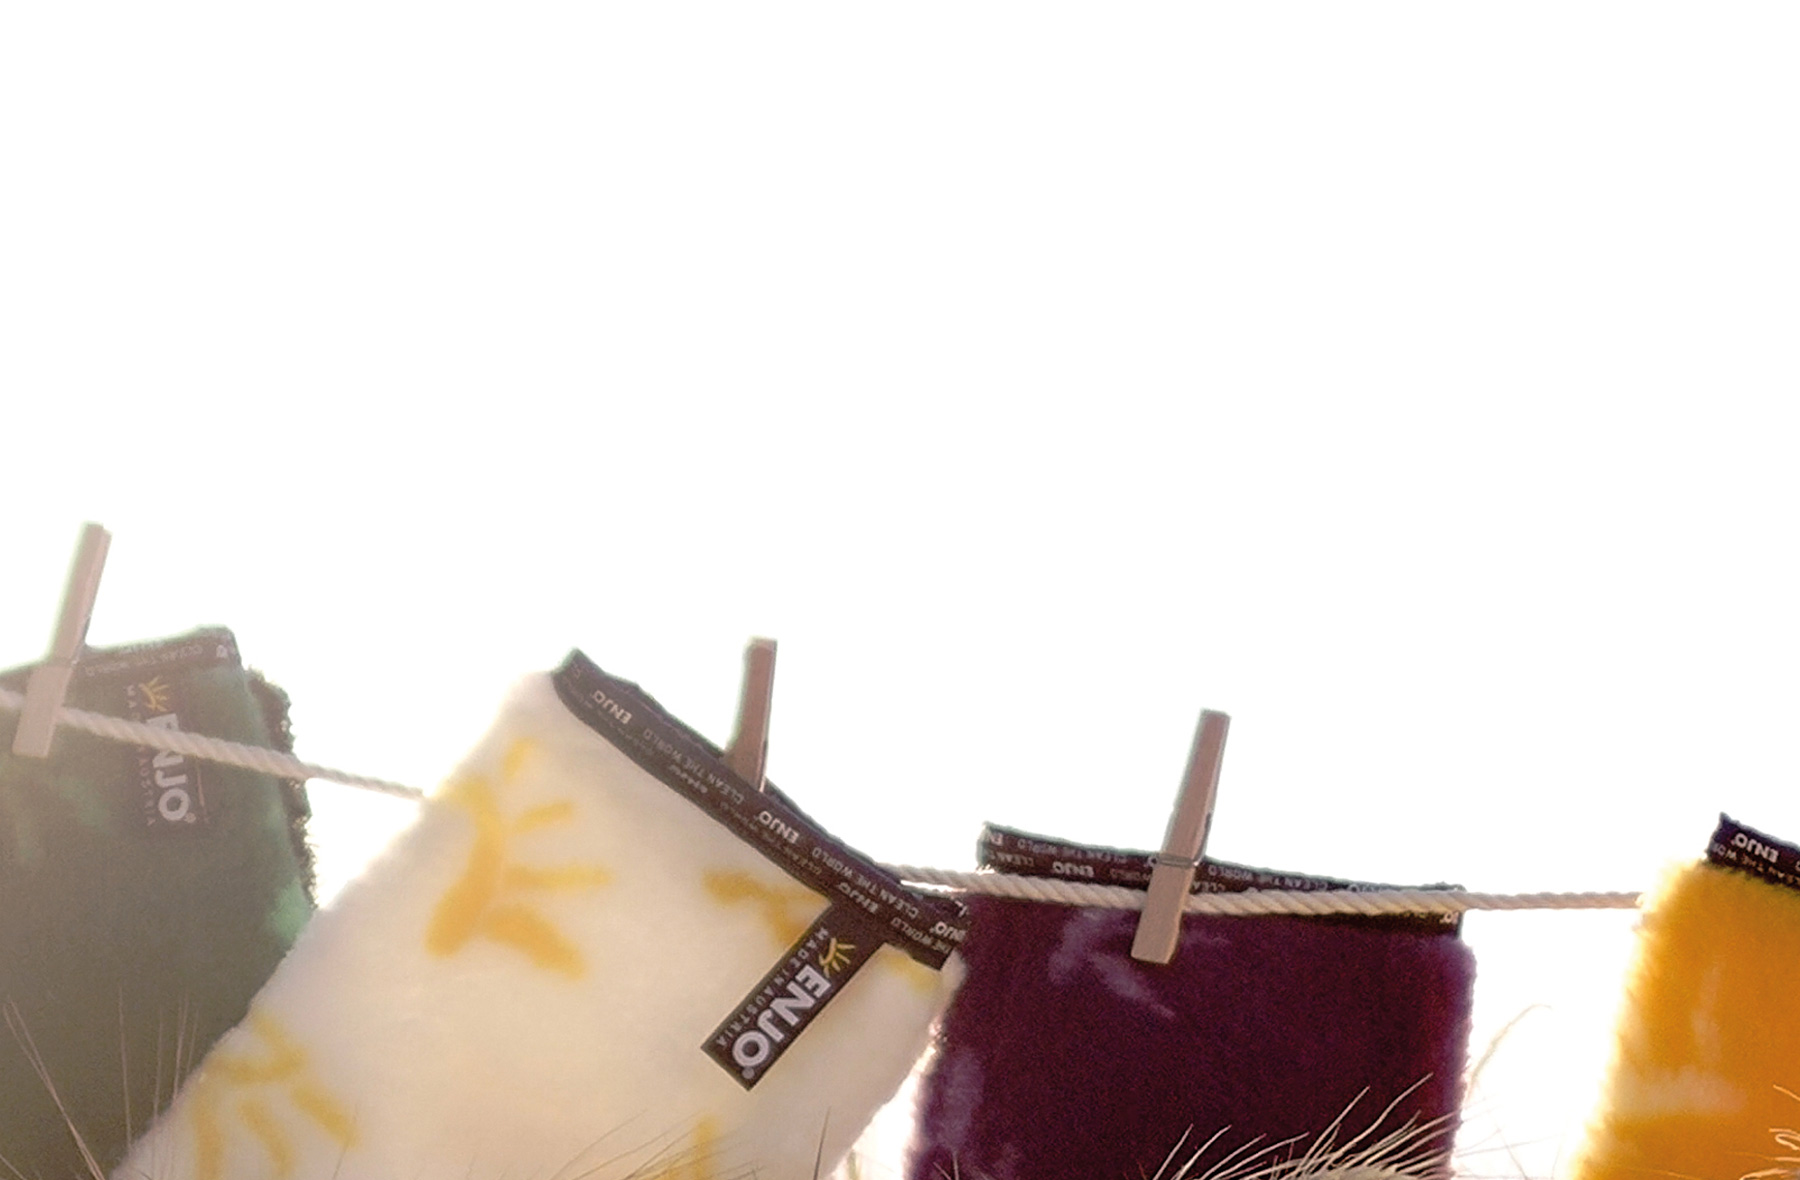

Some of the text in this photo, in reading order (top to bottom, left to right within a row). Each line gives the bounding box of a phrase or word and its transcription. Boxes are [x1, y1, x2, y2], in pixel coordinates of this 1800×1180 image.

[592, 690, 633, 725] ENJO
[642, 728, 682, 763] WORLD
[684, 757, 704, 777] THE
[707, 773, 745, 804] CLEAN
[758, 810, 799, 844] ENJO
[812, 846, 853, 878] WORLD
[1734, 832, 1779, 863] ENJO
[1051, 861, 1094, 877] ENJO
[1207, 864, 1254, 881] WORLD
[1283, 877, 1328, 889] CLEAN
[856, 875, 877, 895] THE
[879, 888, 919, 919] CLEAN
[891, 916, 932, 947] WORLD
[789, 927, 829, 969] MADE
[716, 986, 775, 1046] AUSTRIA
[732, 964, 832, 1068] ENJO
